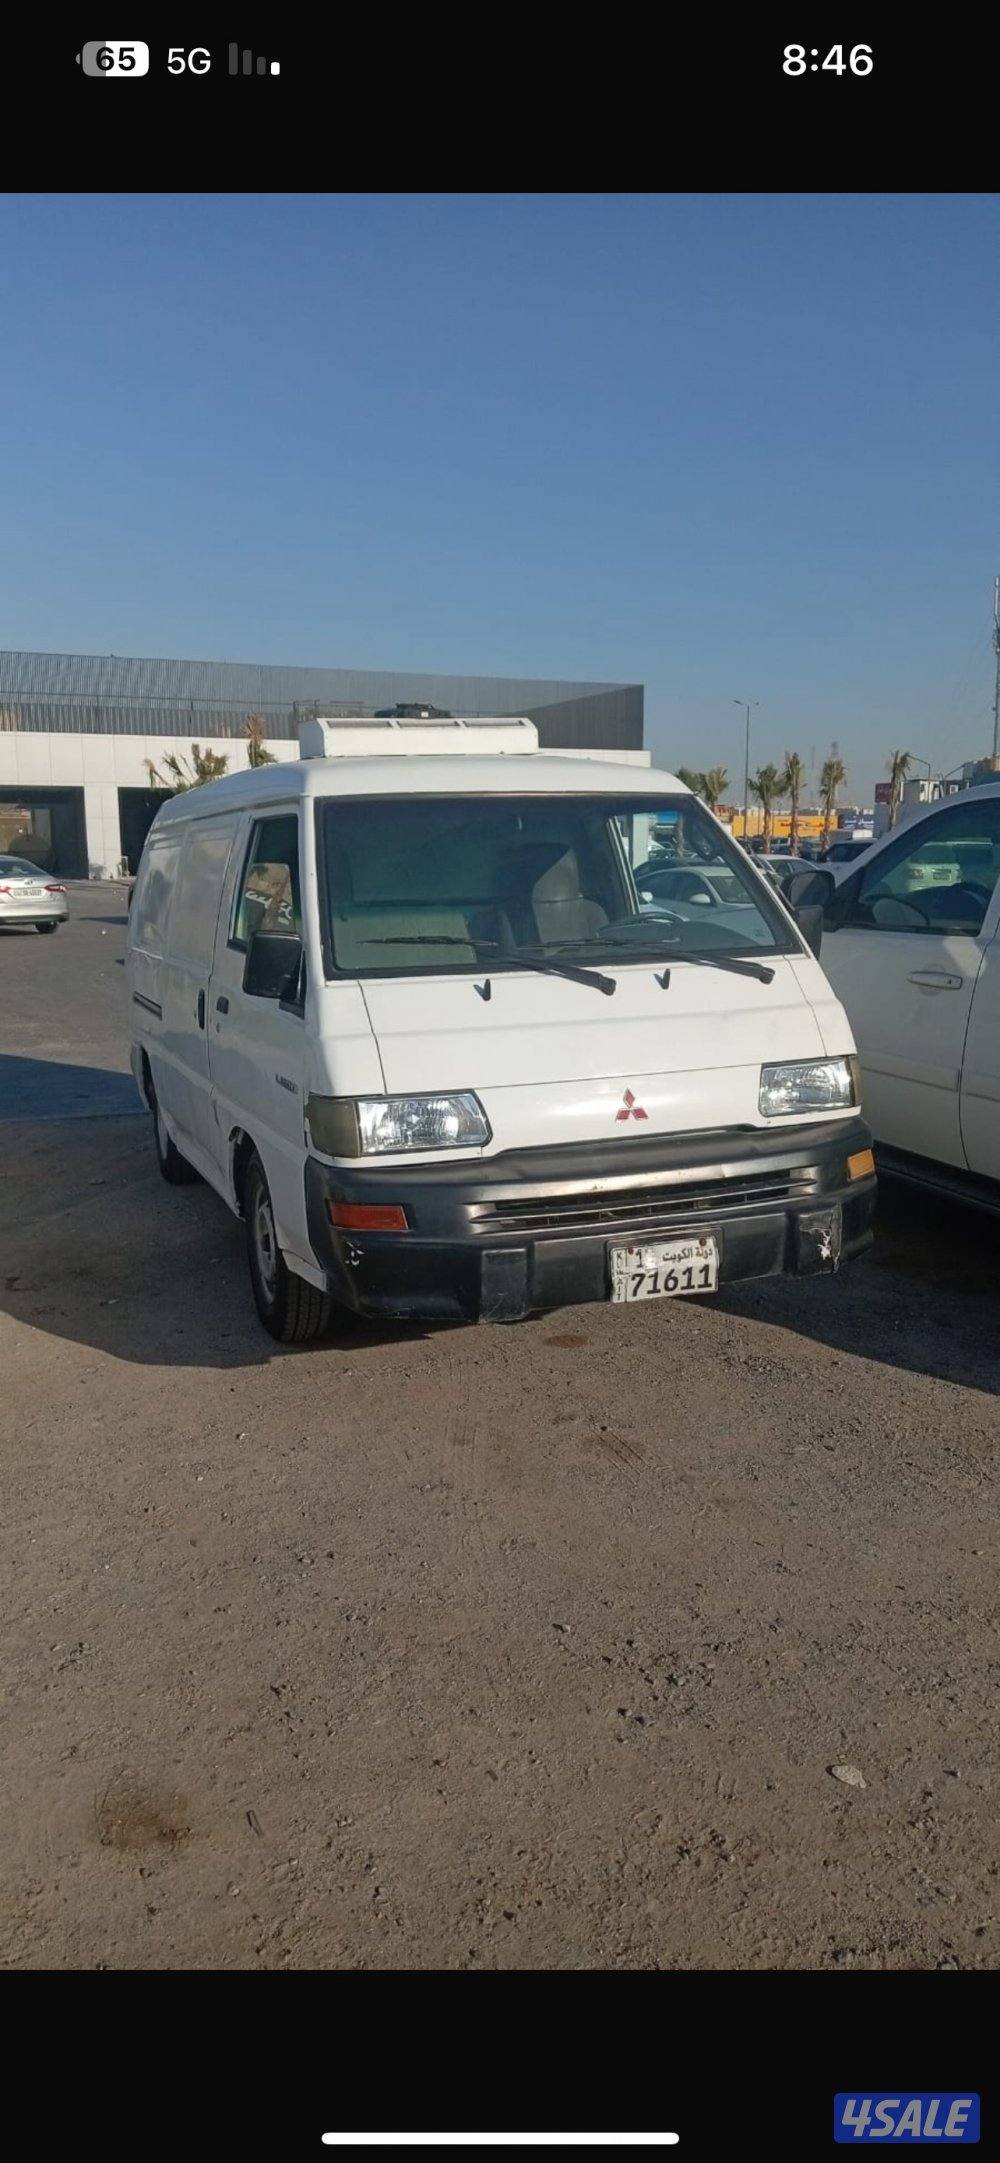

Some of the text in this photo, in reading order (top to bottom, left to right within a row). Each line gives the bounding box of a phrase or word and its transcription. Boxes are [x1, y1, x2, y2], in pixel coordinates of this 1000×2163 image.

[662, 1246, 713, 1262] دولة الكويت
[631, 1264, 712, 1297] 71611
